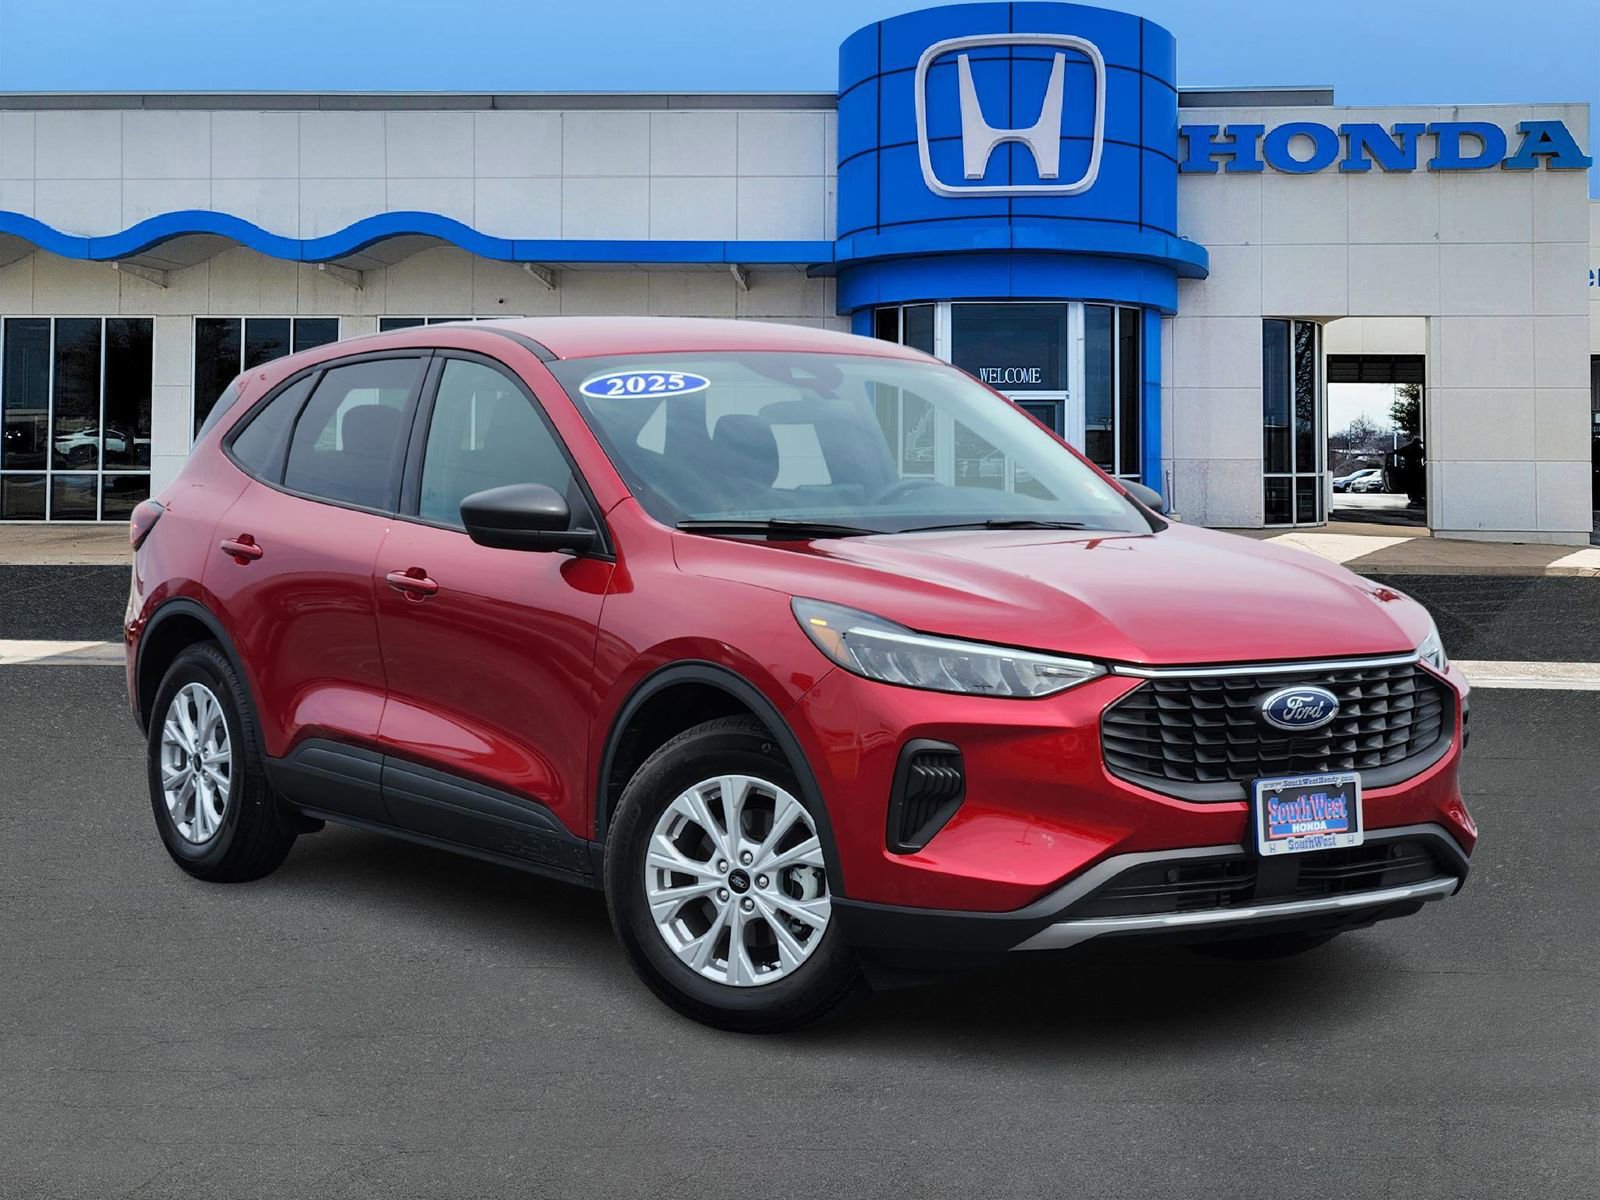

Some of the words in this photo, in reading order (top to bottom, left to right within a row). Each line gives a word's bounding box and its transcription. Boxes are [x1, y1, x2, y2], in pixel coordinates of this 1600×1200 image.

[1178, 120, 1593, 174] HONDA
[606, 374, 686, 396] 2025
[979, 367, 1042, 384] WELCOME
[1282, 695, 1325, 721] Ford
[1267, 791, 1349, 825] SouthWest
[1291, 820, 1328, 834] HONDA
[1287, 835, 1337, 851] SouthWest
